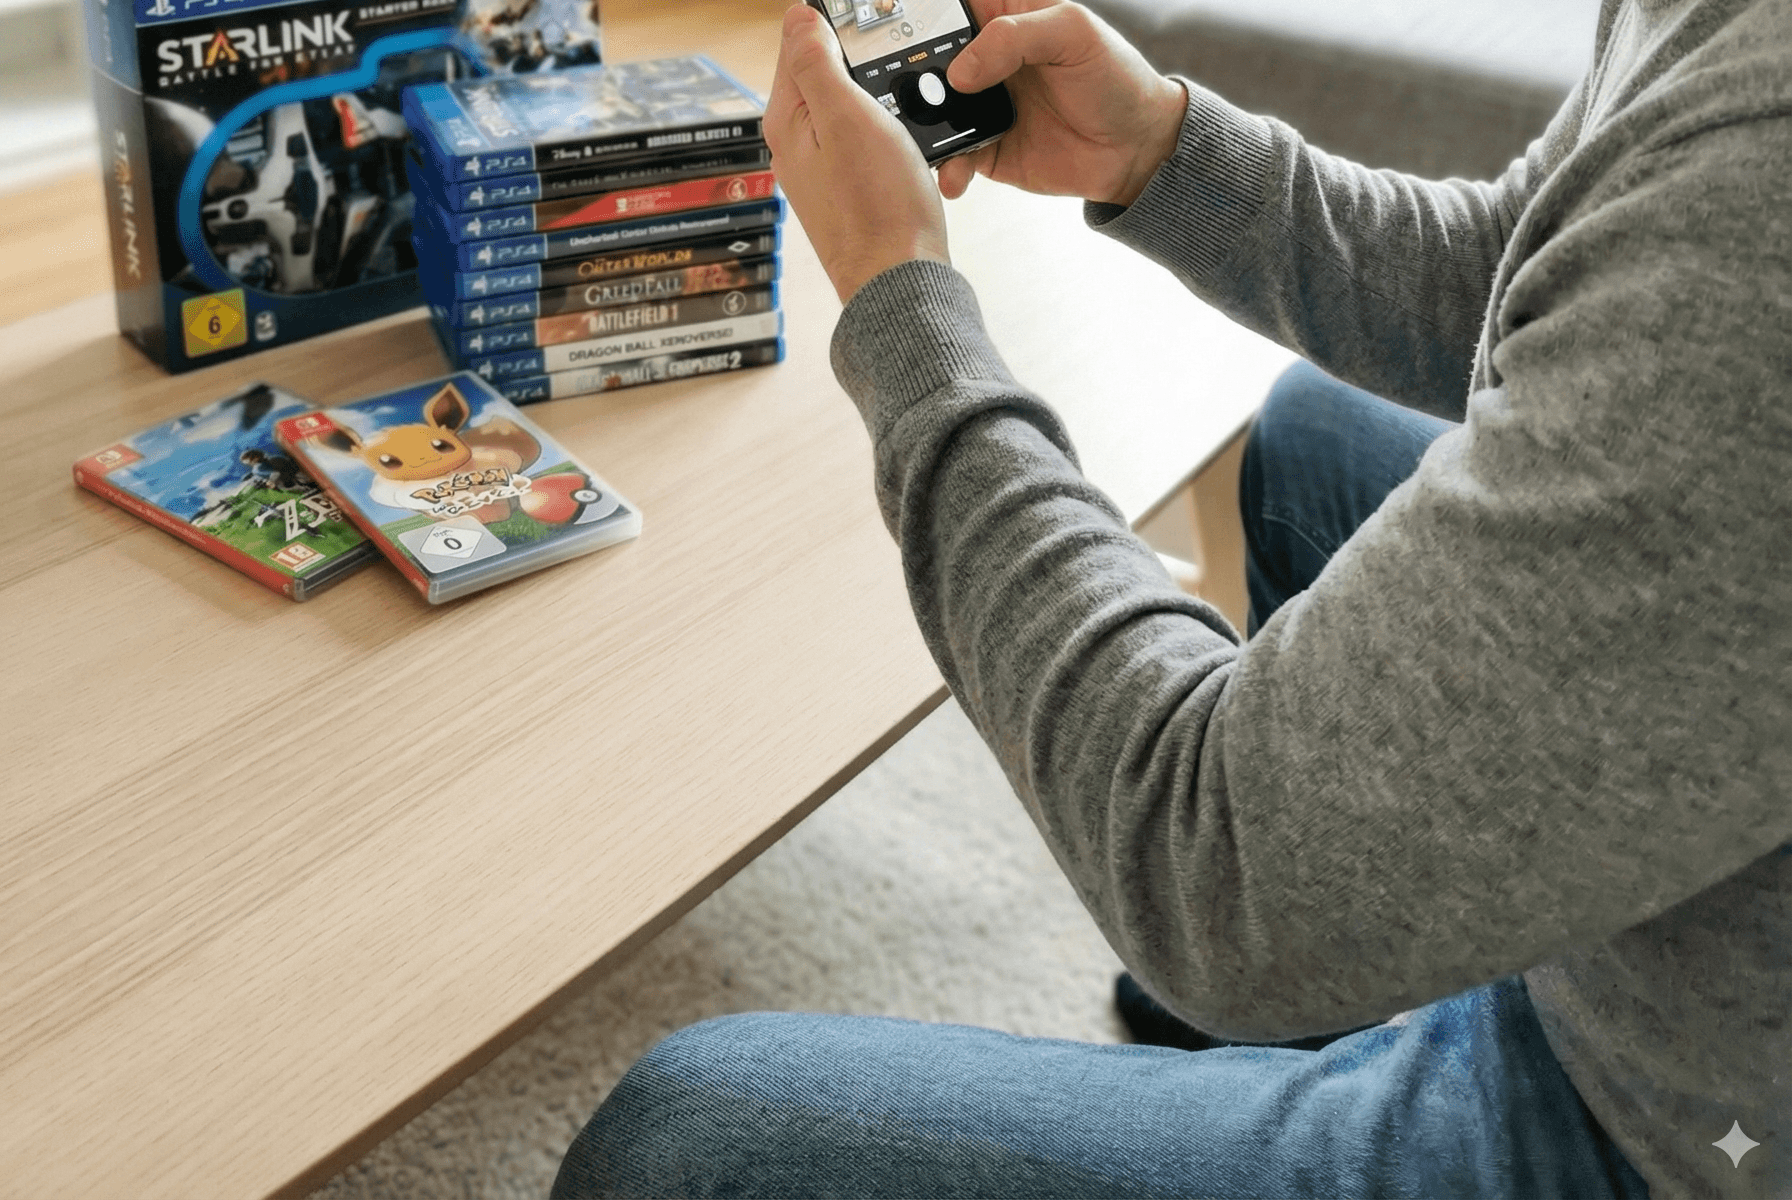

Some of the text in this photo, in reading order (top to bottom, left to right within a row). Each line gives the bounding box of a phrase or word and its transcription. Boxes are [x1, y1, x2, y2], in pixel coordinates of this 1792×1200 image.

[157, 10, 354, 74] STARLINK
[486, 156, 527, 170] PS4
[491, 185, 532, 199] PS4
[487, 215, 527, 230] PS4
[498, 243, 538, 258] PS4
[492, 274, 532, 288] PS4
[490, 304, 530, 318] PS4
[207, 315, 221, 335] 6
[568, 344, 622, 363] DRAGON
[625, 339, 655, 353] BALL
[443, 537, 463, 551] 0
